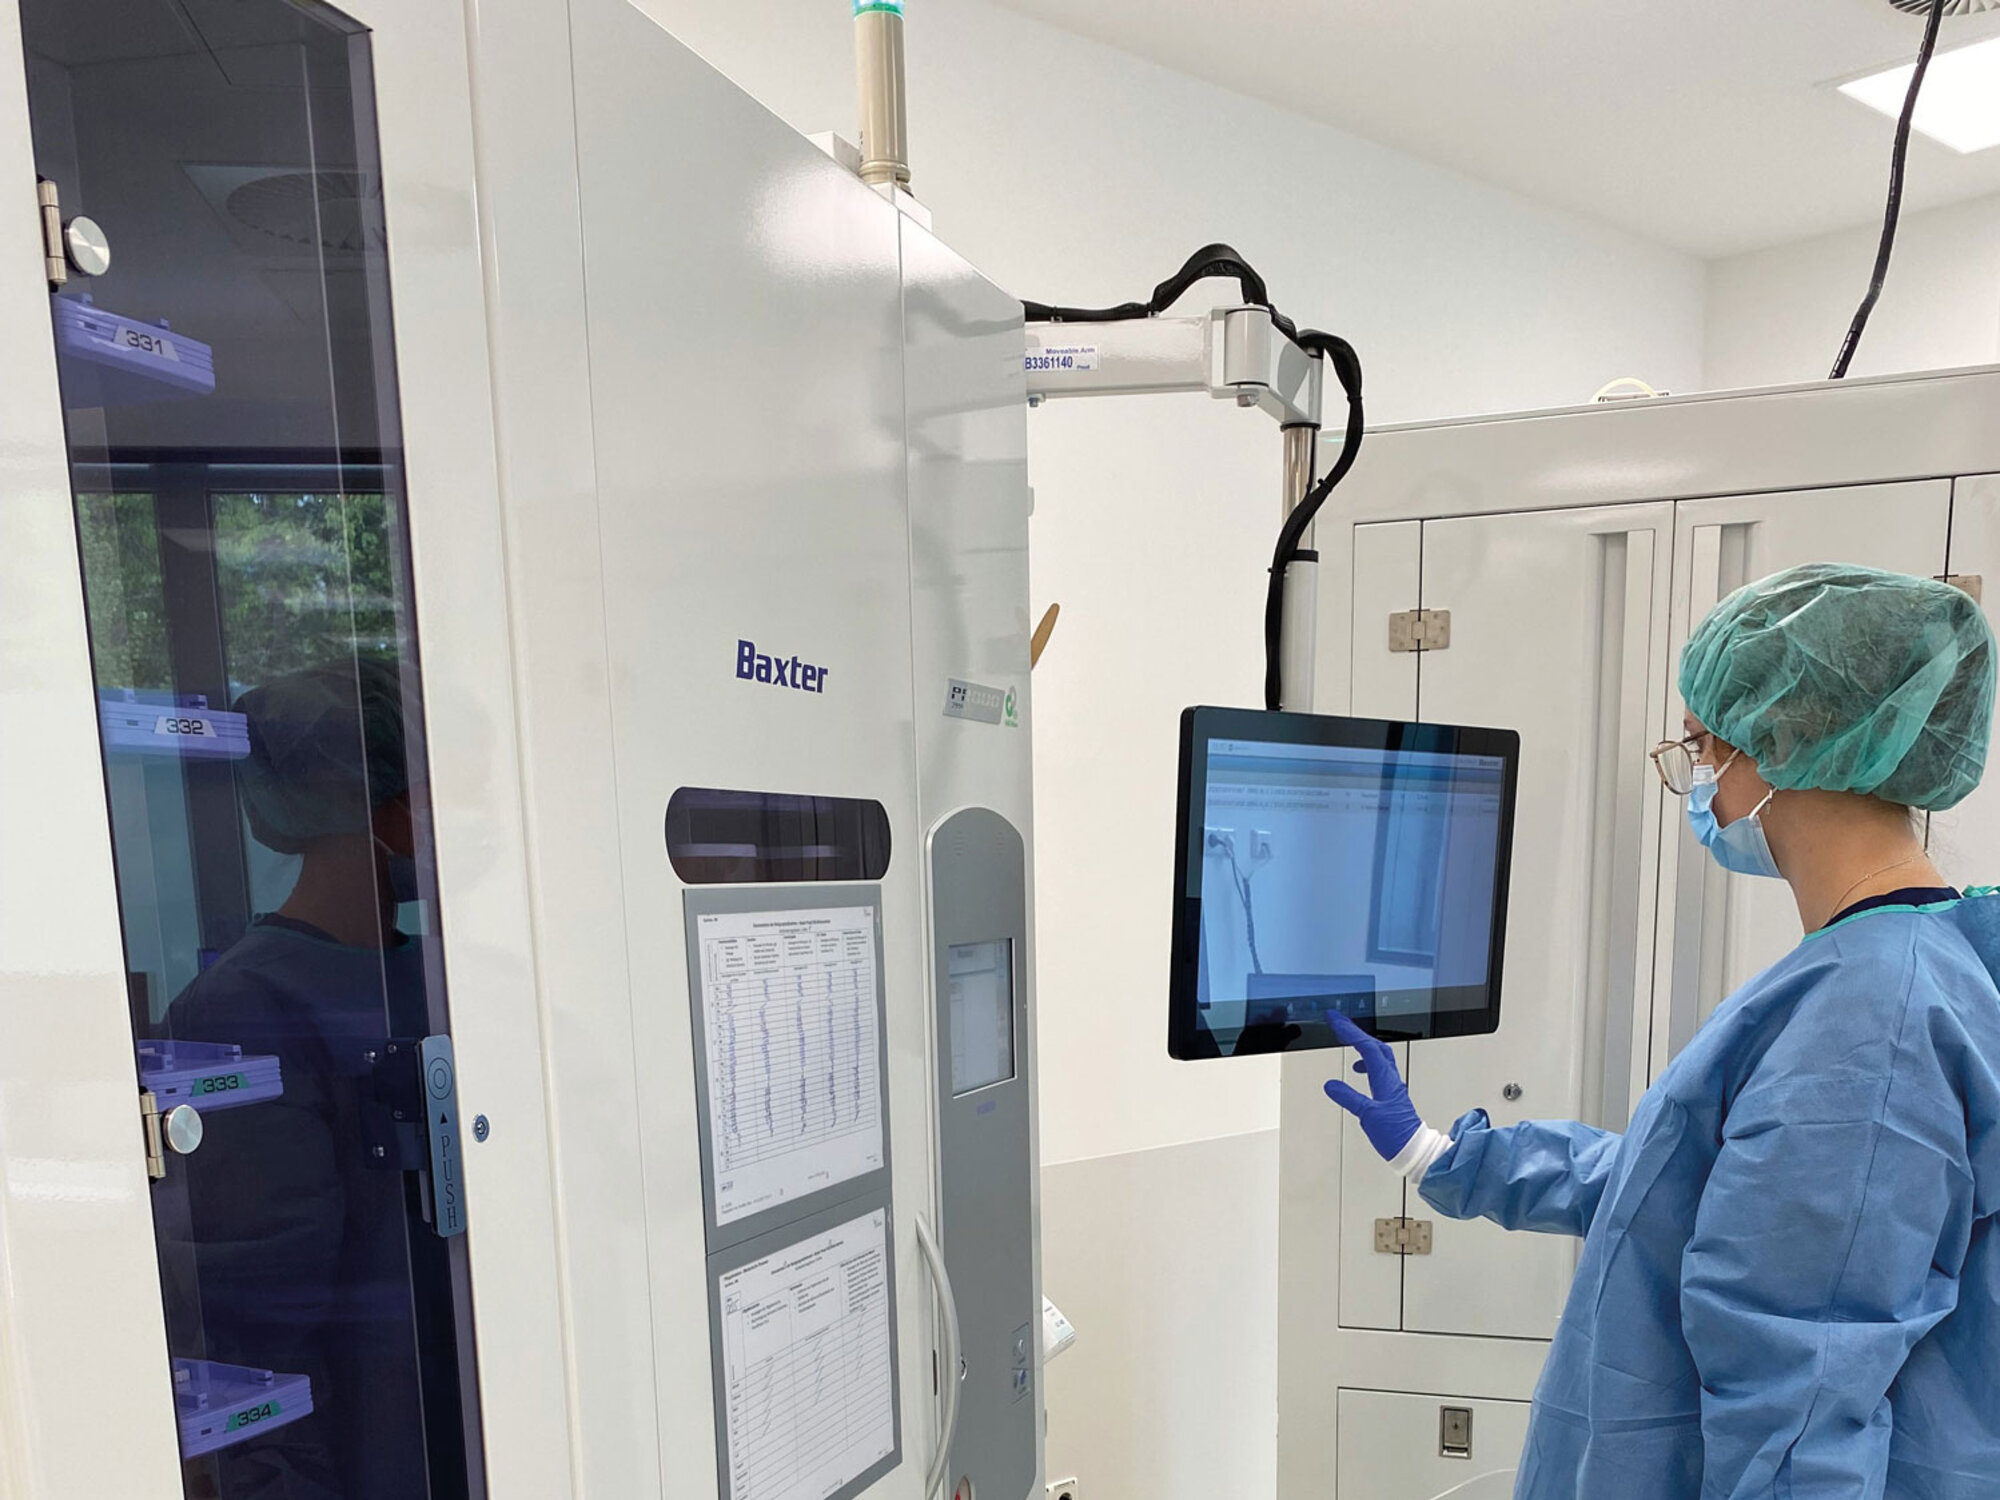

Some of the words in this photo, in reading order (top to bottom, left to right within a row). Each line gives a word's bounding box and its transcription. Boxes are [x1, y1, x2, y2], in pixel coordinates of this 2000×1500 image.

[126, 329, 163, 354] 331
[1024, 356, 1073, 370] B3361140
[736, 639, 829, 693] Baxter
[165, 718, 205, 736] 332
[202, 1075, 240, 1094] 333
[441, 1135, 458, 1229] PUSH
[236, 1403, 272, 1427] 334
